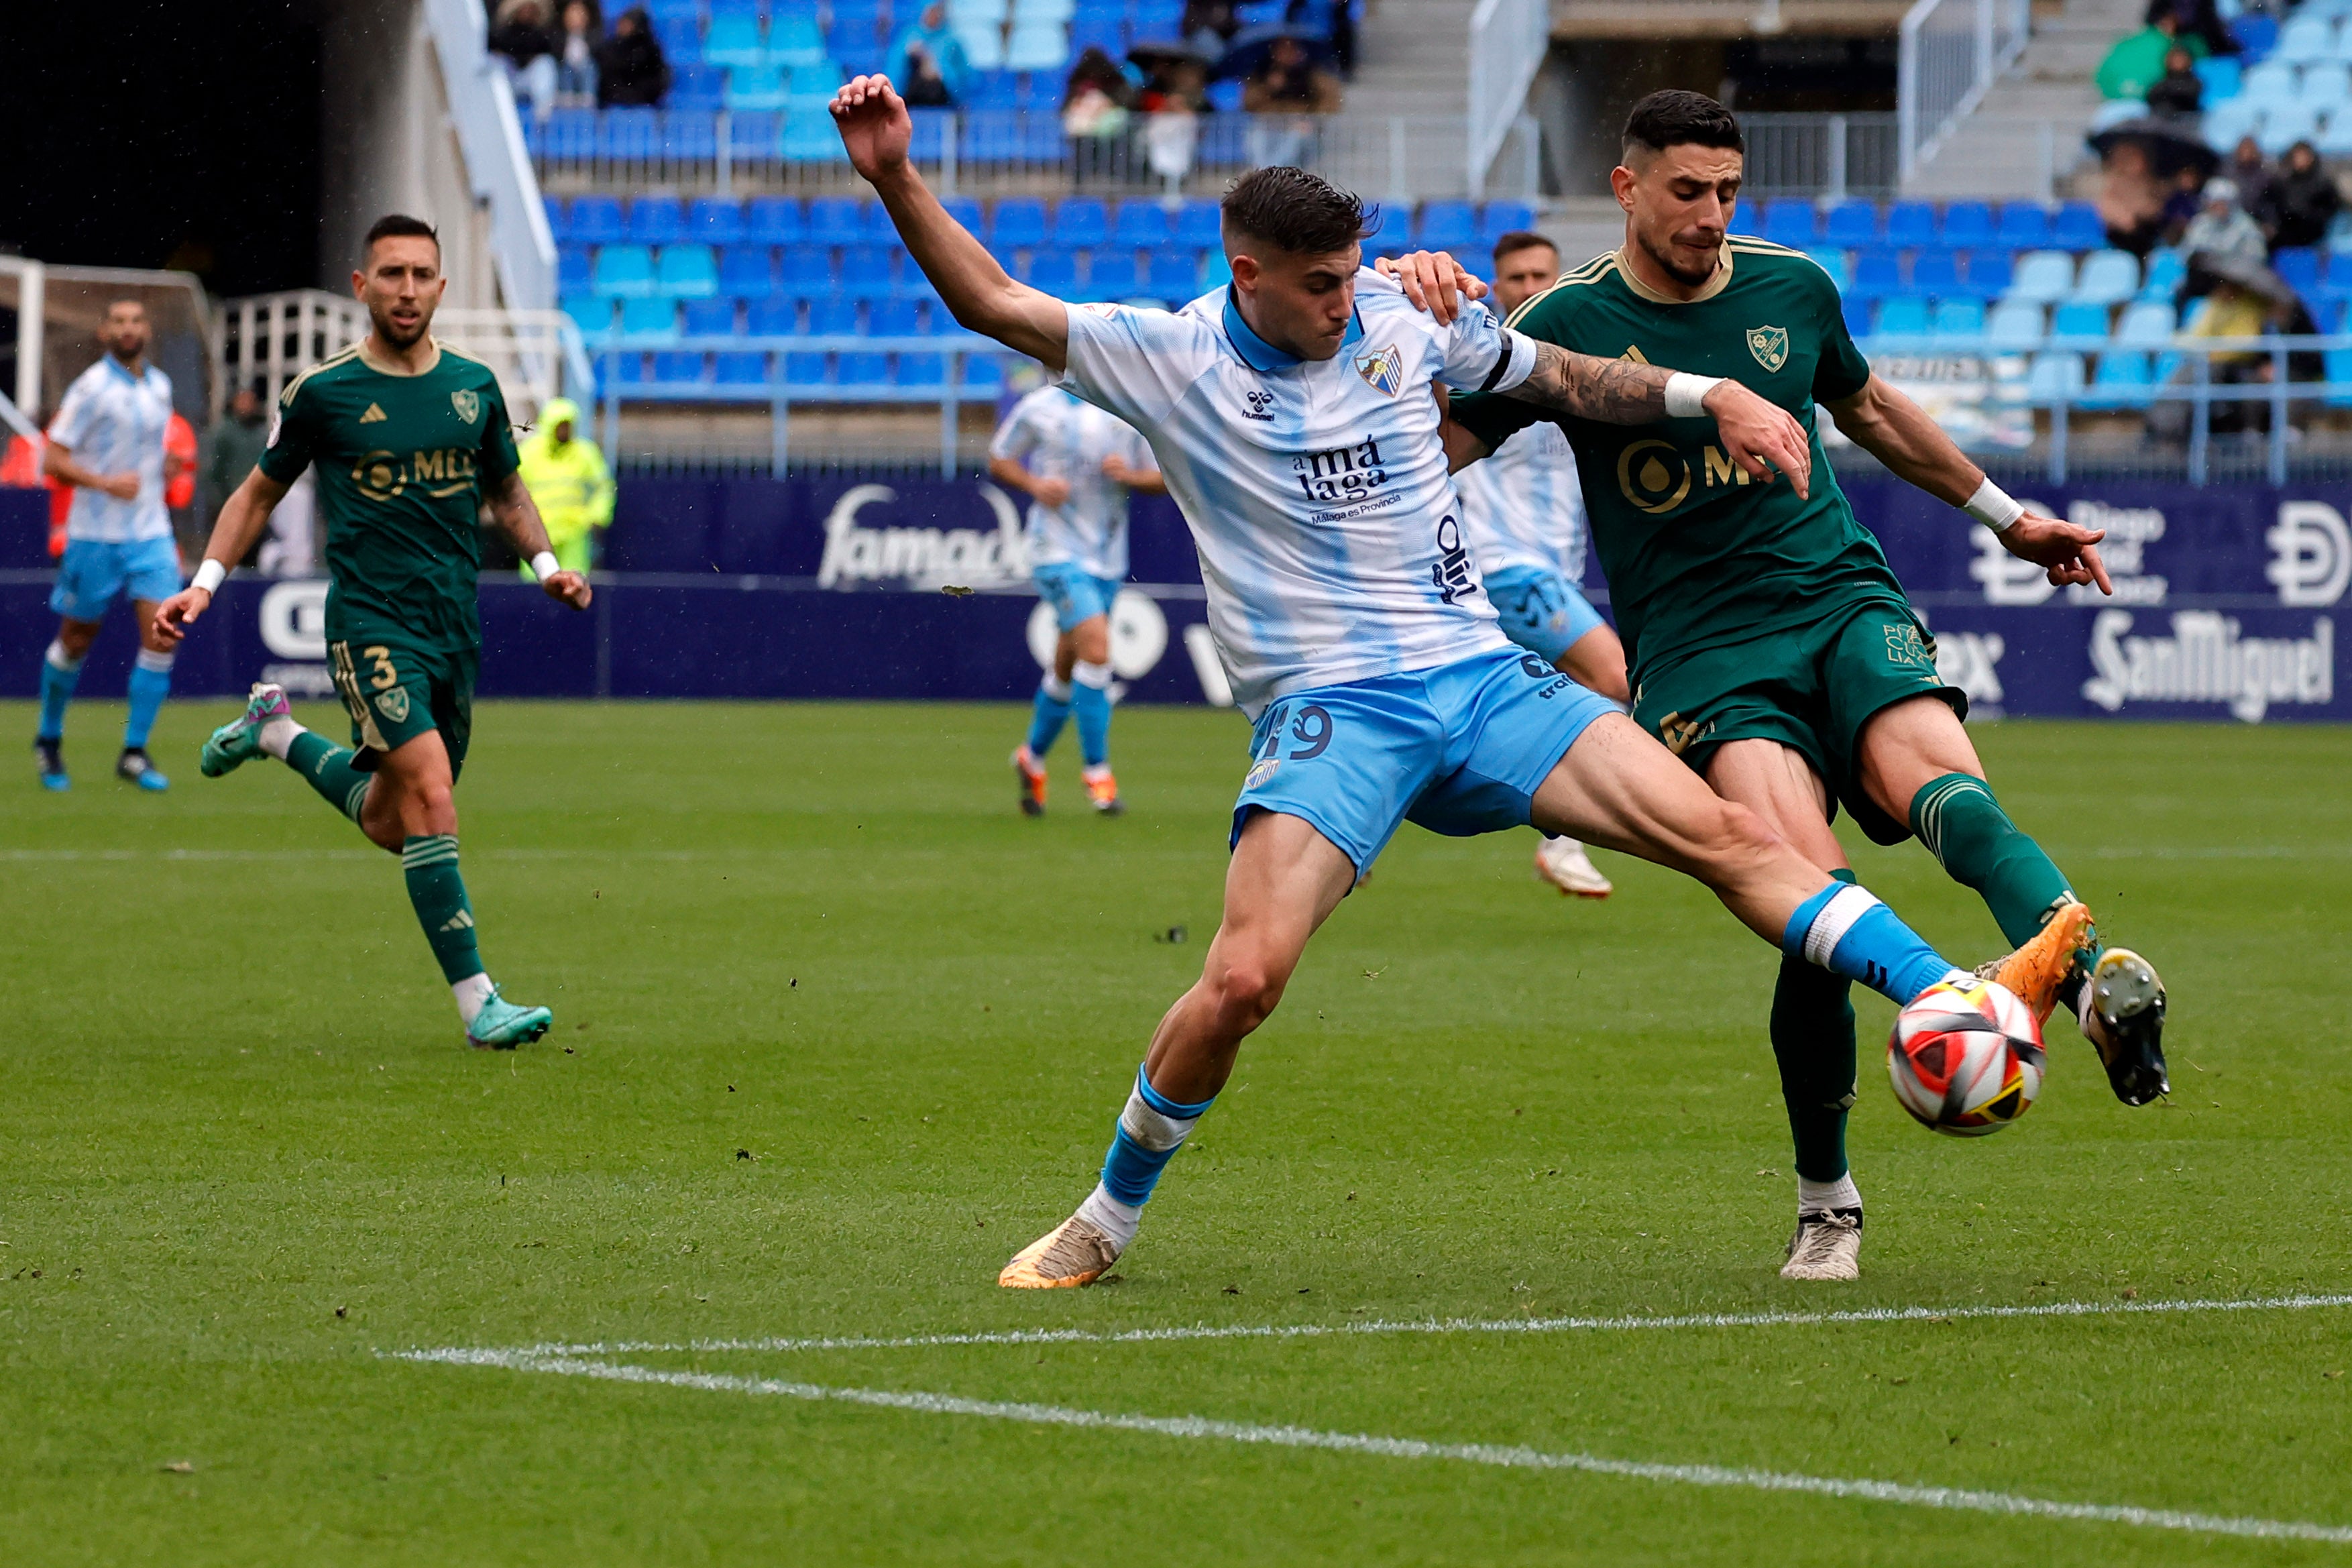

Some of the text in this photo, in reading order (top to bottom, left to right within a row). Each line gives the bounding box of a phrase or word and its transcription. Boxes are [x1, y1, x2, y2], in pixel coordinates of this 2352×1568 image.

[1242, 409, 1275, 422] hummel
[1311, 511, 1347, 525] Málaga
[1347, 509, 1360, 518] es
[363, 645, 397, 690] 3
[1264, 704, 1333, 761] 19
